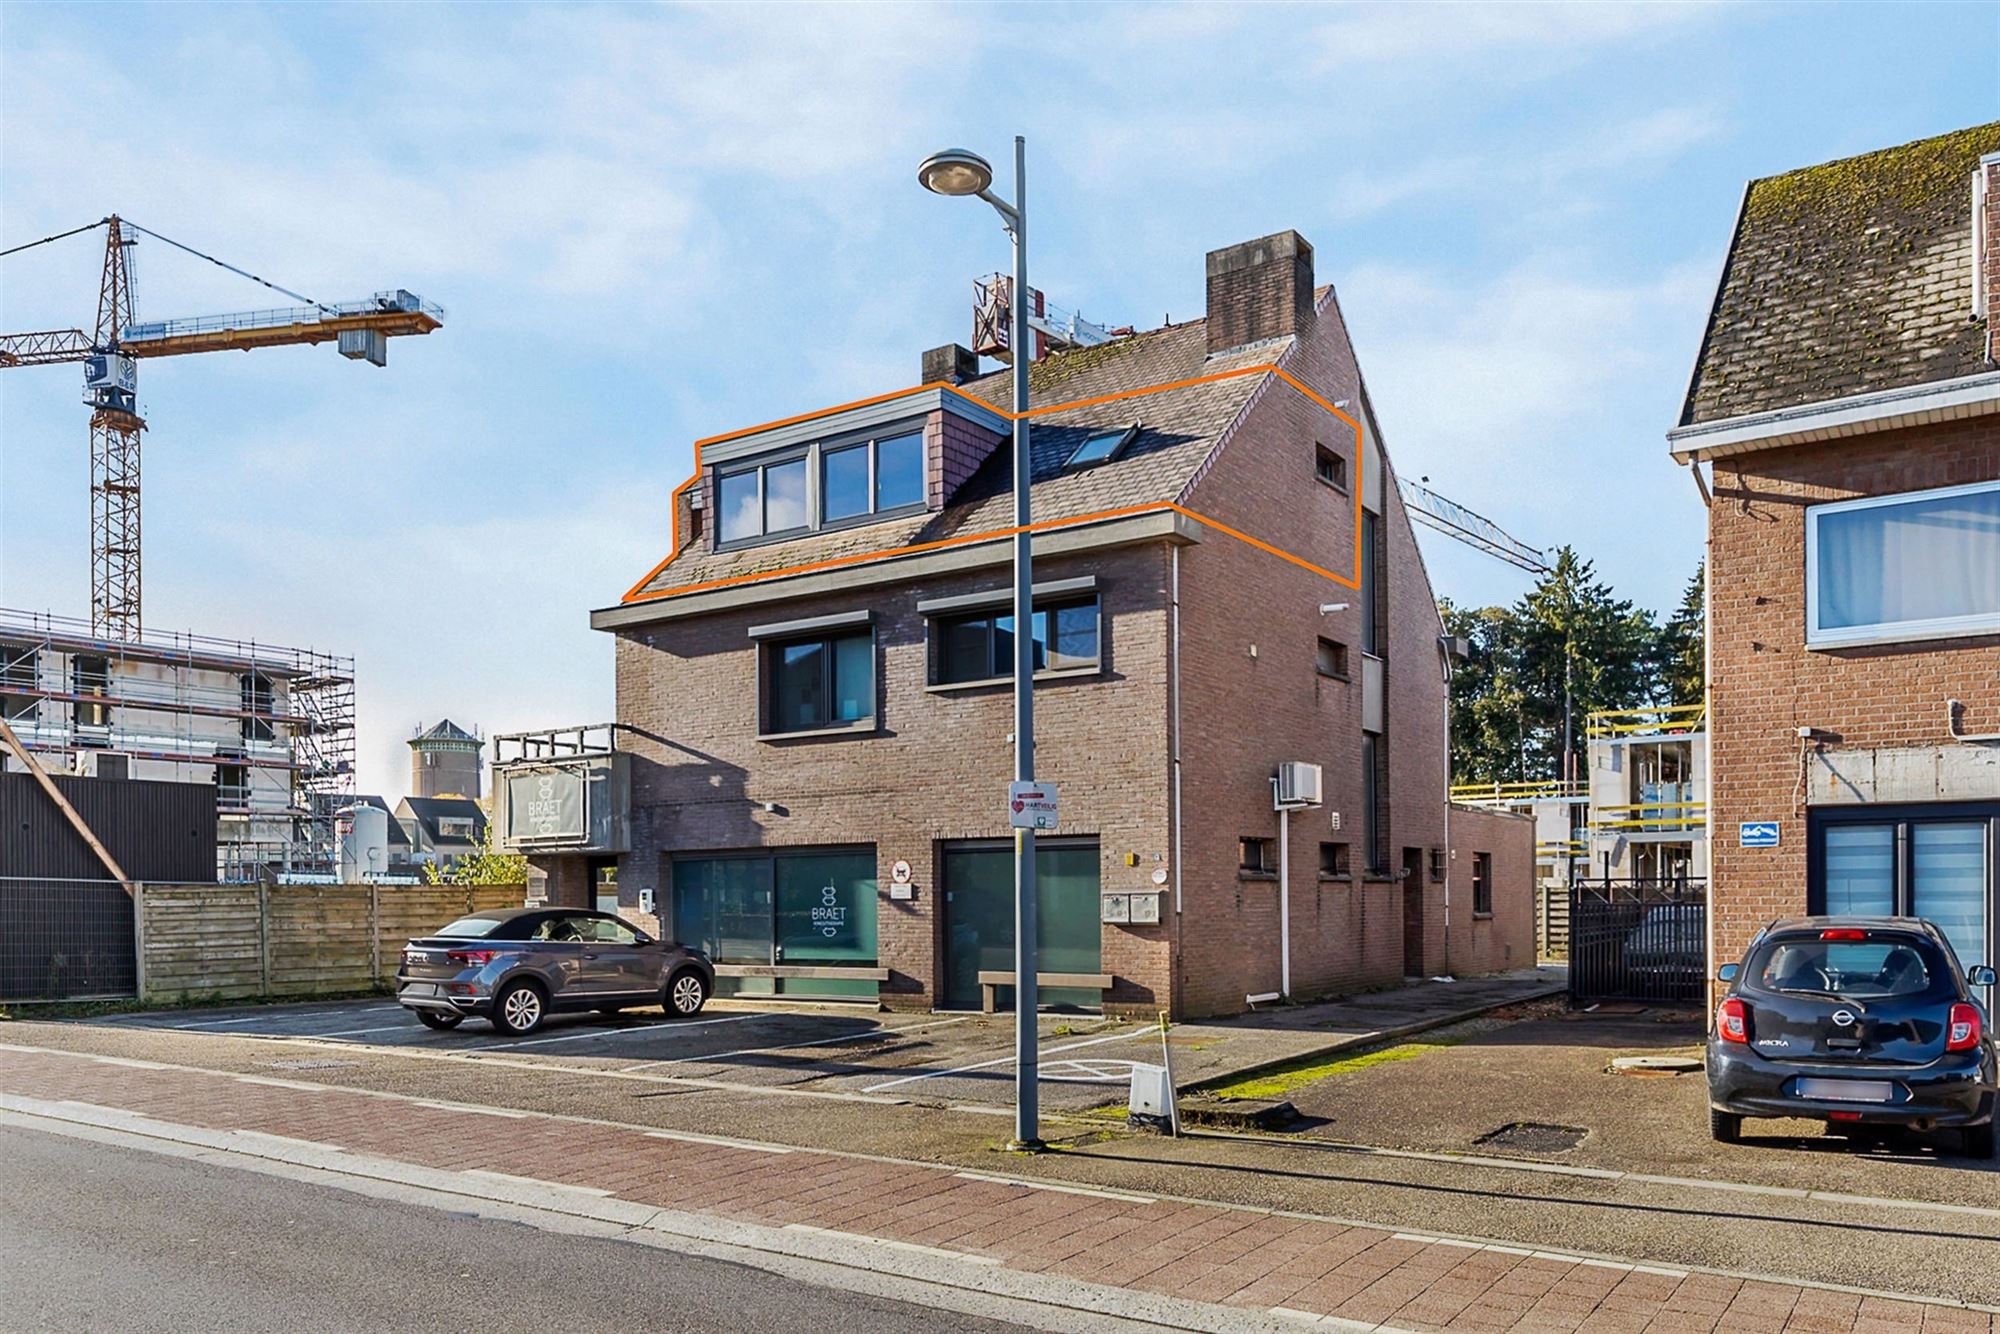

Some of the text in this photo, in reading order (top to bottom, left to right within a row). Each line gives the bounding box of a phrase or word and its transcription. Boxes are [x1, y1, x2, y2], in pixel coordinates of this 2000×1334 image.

[528, 799, 562, 816] BRAET
[811, 907, 846, 920] BRAET
[1759, 1039, 1789, 1047] MICRA
